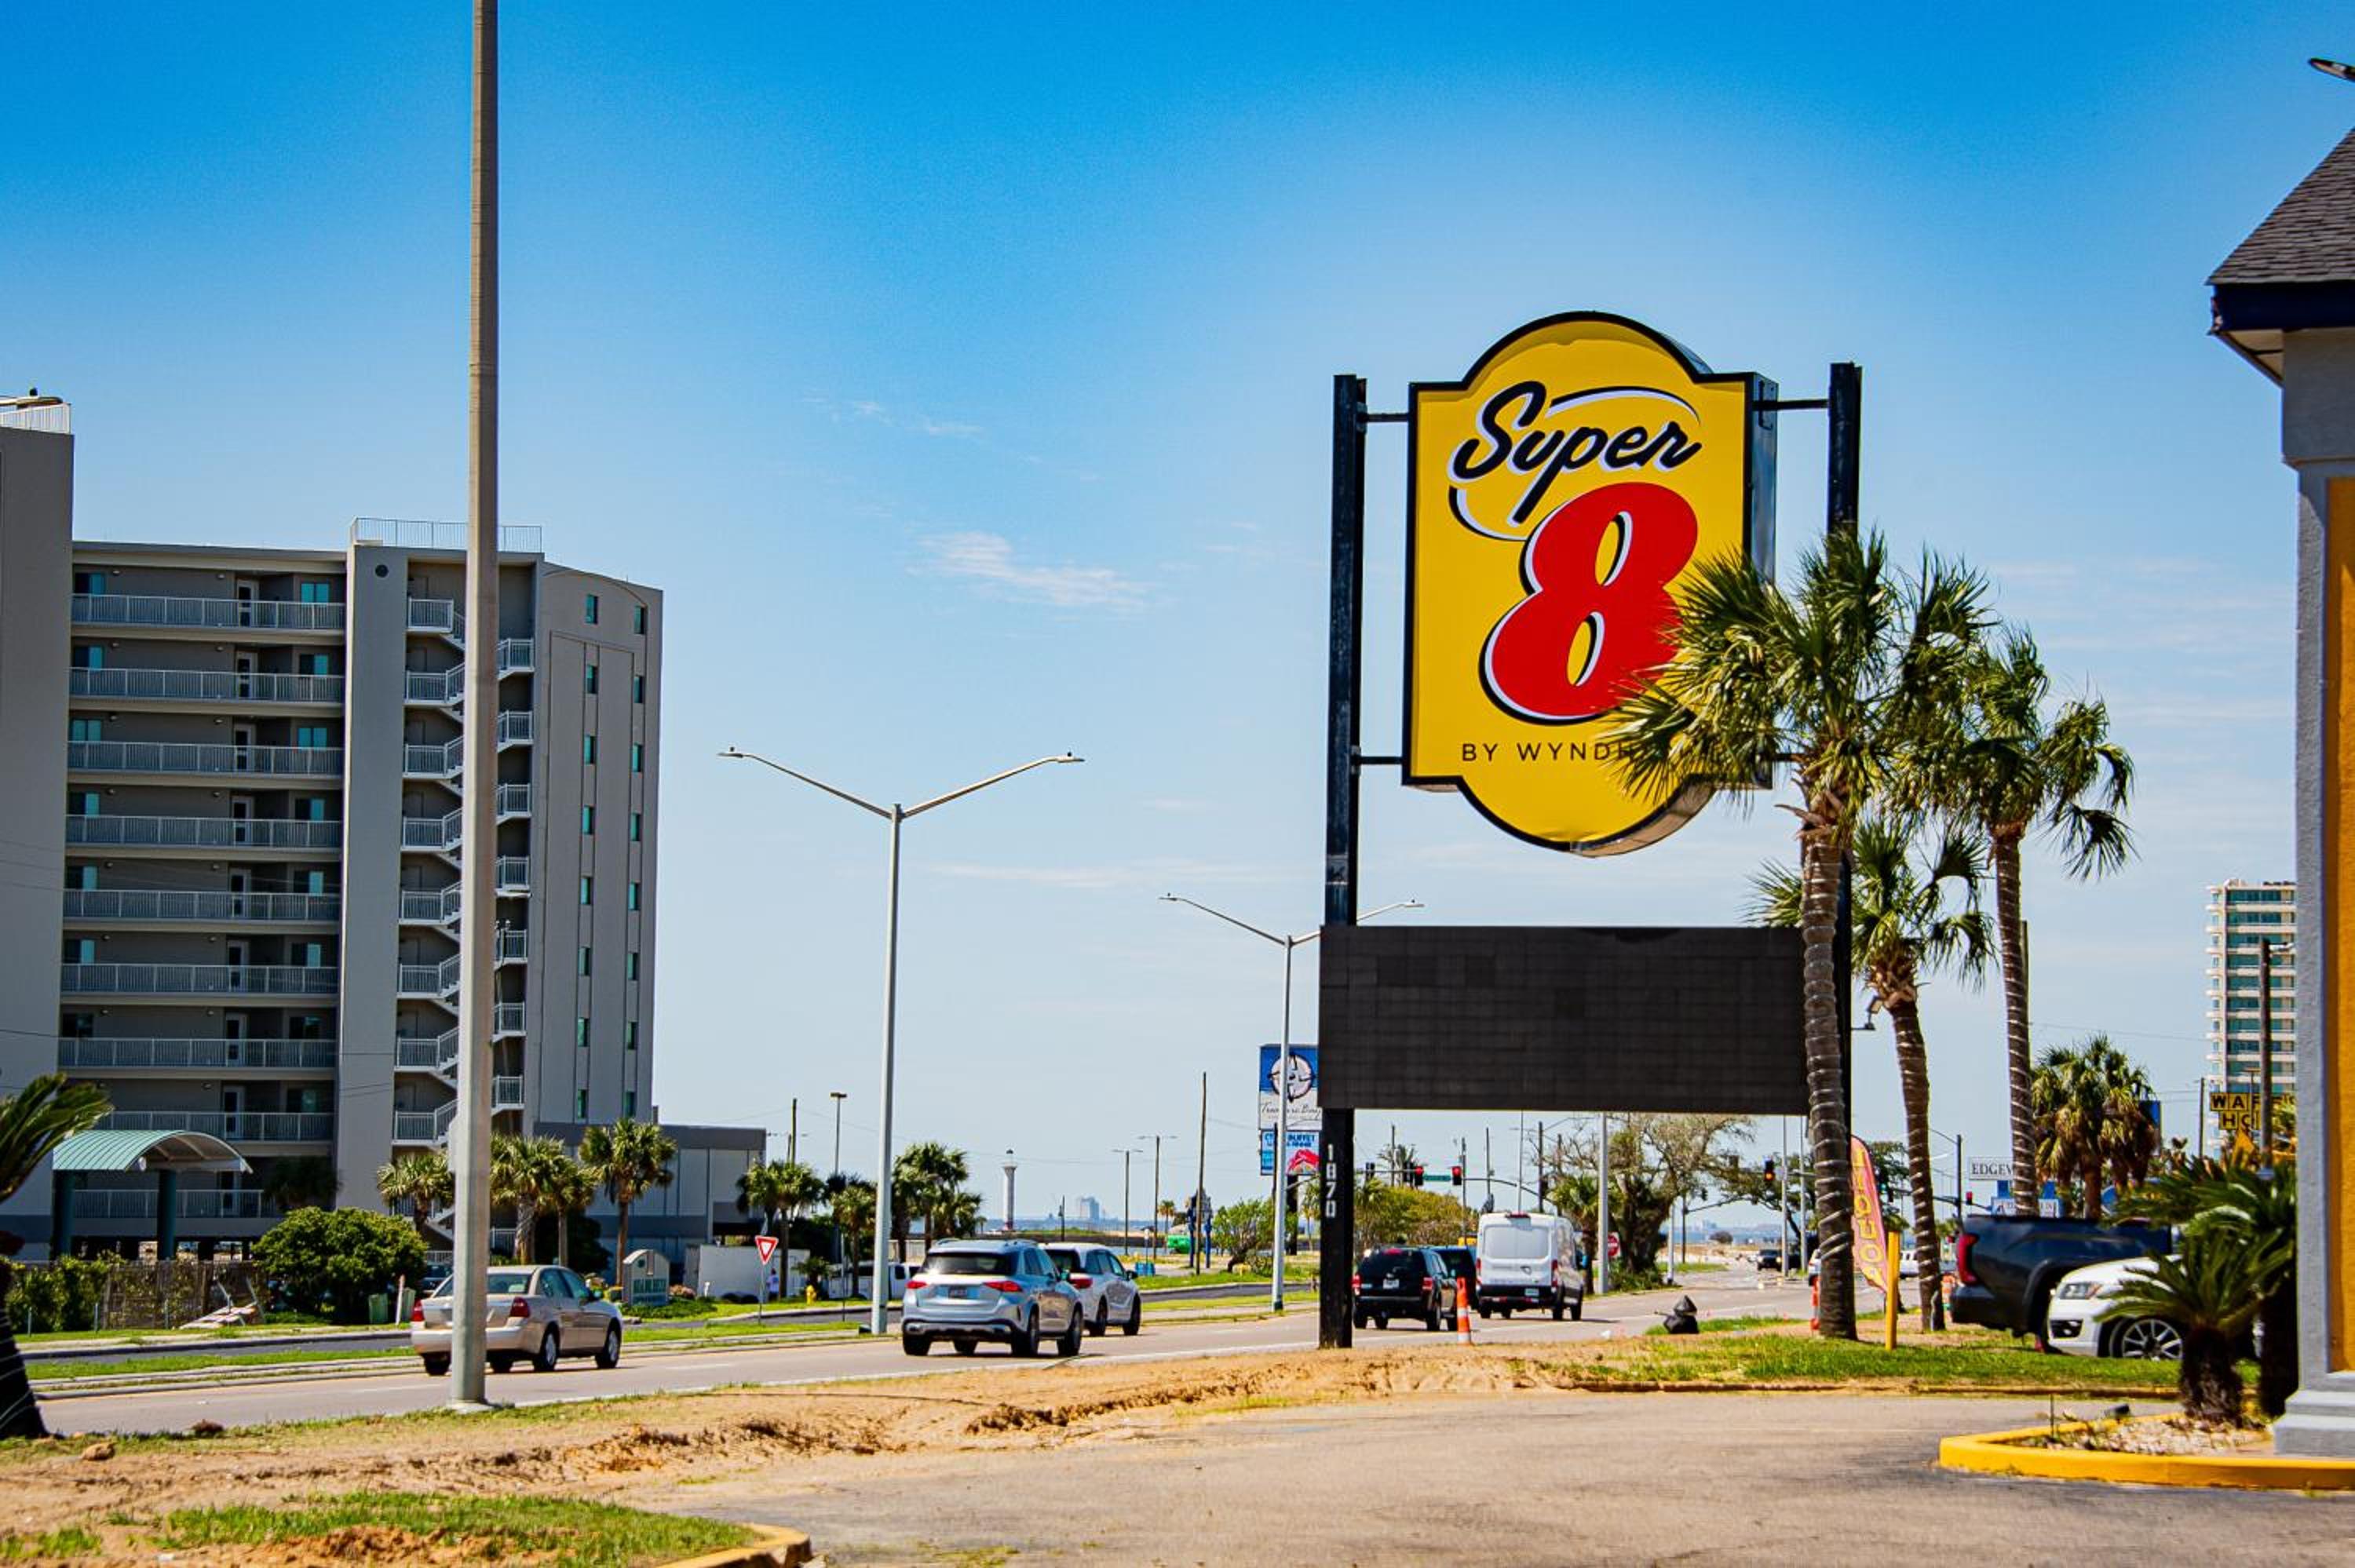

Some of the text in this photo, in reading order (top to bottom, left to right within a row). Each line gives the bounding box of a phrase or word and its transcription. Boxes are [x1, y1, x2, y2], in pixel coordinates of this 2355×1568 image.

[1449, 381, 1702, 524] Super
[1478, 482, 1698, 727] 8
[1462, 743, 1498, 761] BY
[1326, 1143, 1337, 1218] 1870
